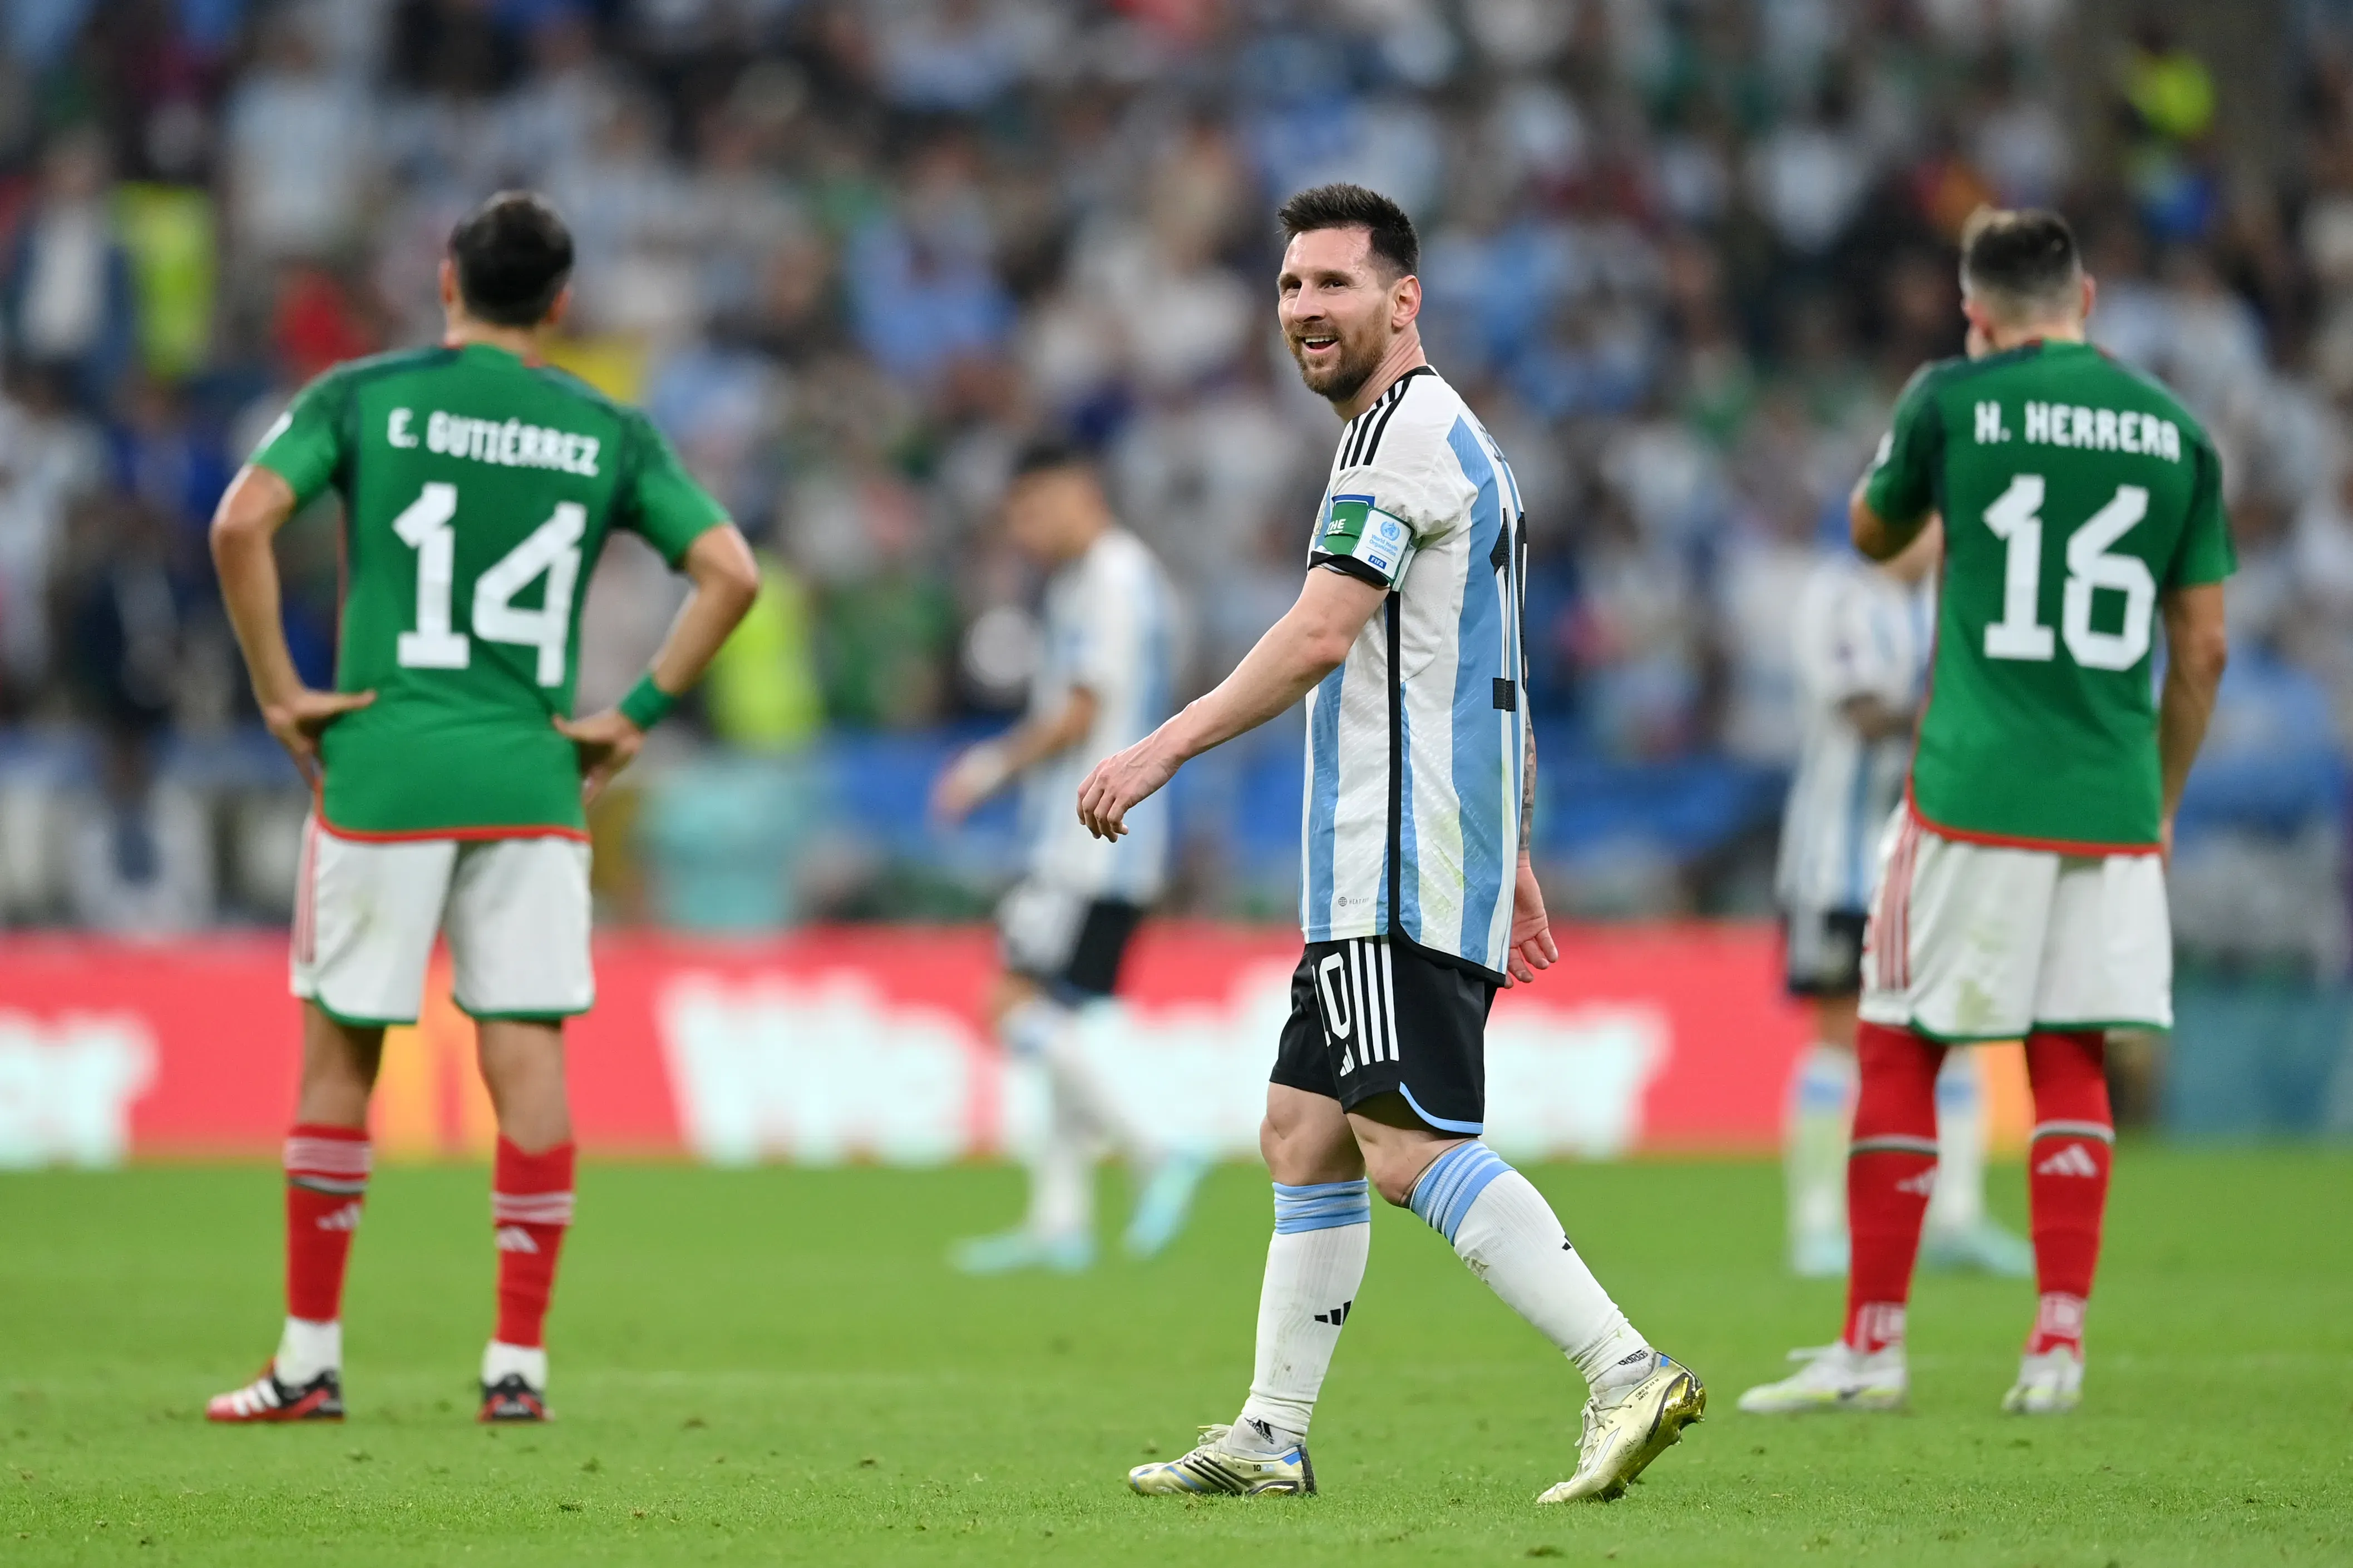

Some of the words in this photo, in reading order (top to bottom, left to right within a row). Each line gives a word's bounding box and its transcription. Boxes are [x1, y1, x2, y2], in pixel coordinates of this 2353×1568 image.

[387, 407, 418, 448] E.
[426, 410, 600, 477] GUTIÉRREZ
[1974, 401, 2010, 443] H.
[2025, 401, 2181, 463] HERRERA
[1370, 557, 1384, 567] FIFA
[1372, 534, 1386, 544] World
[392, 482, 588, 687] 14
[1982, 474, 2157, 671] 16
[1311, 952, 1351, 1047] 0
[1253, 1464, 1261, 1472] 10
